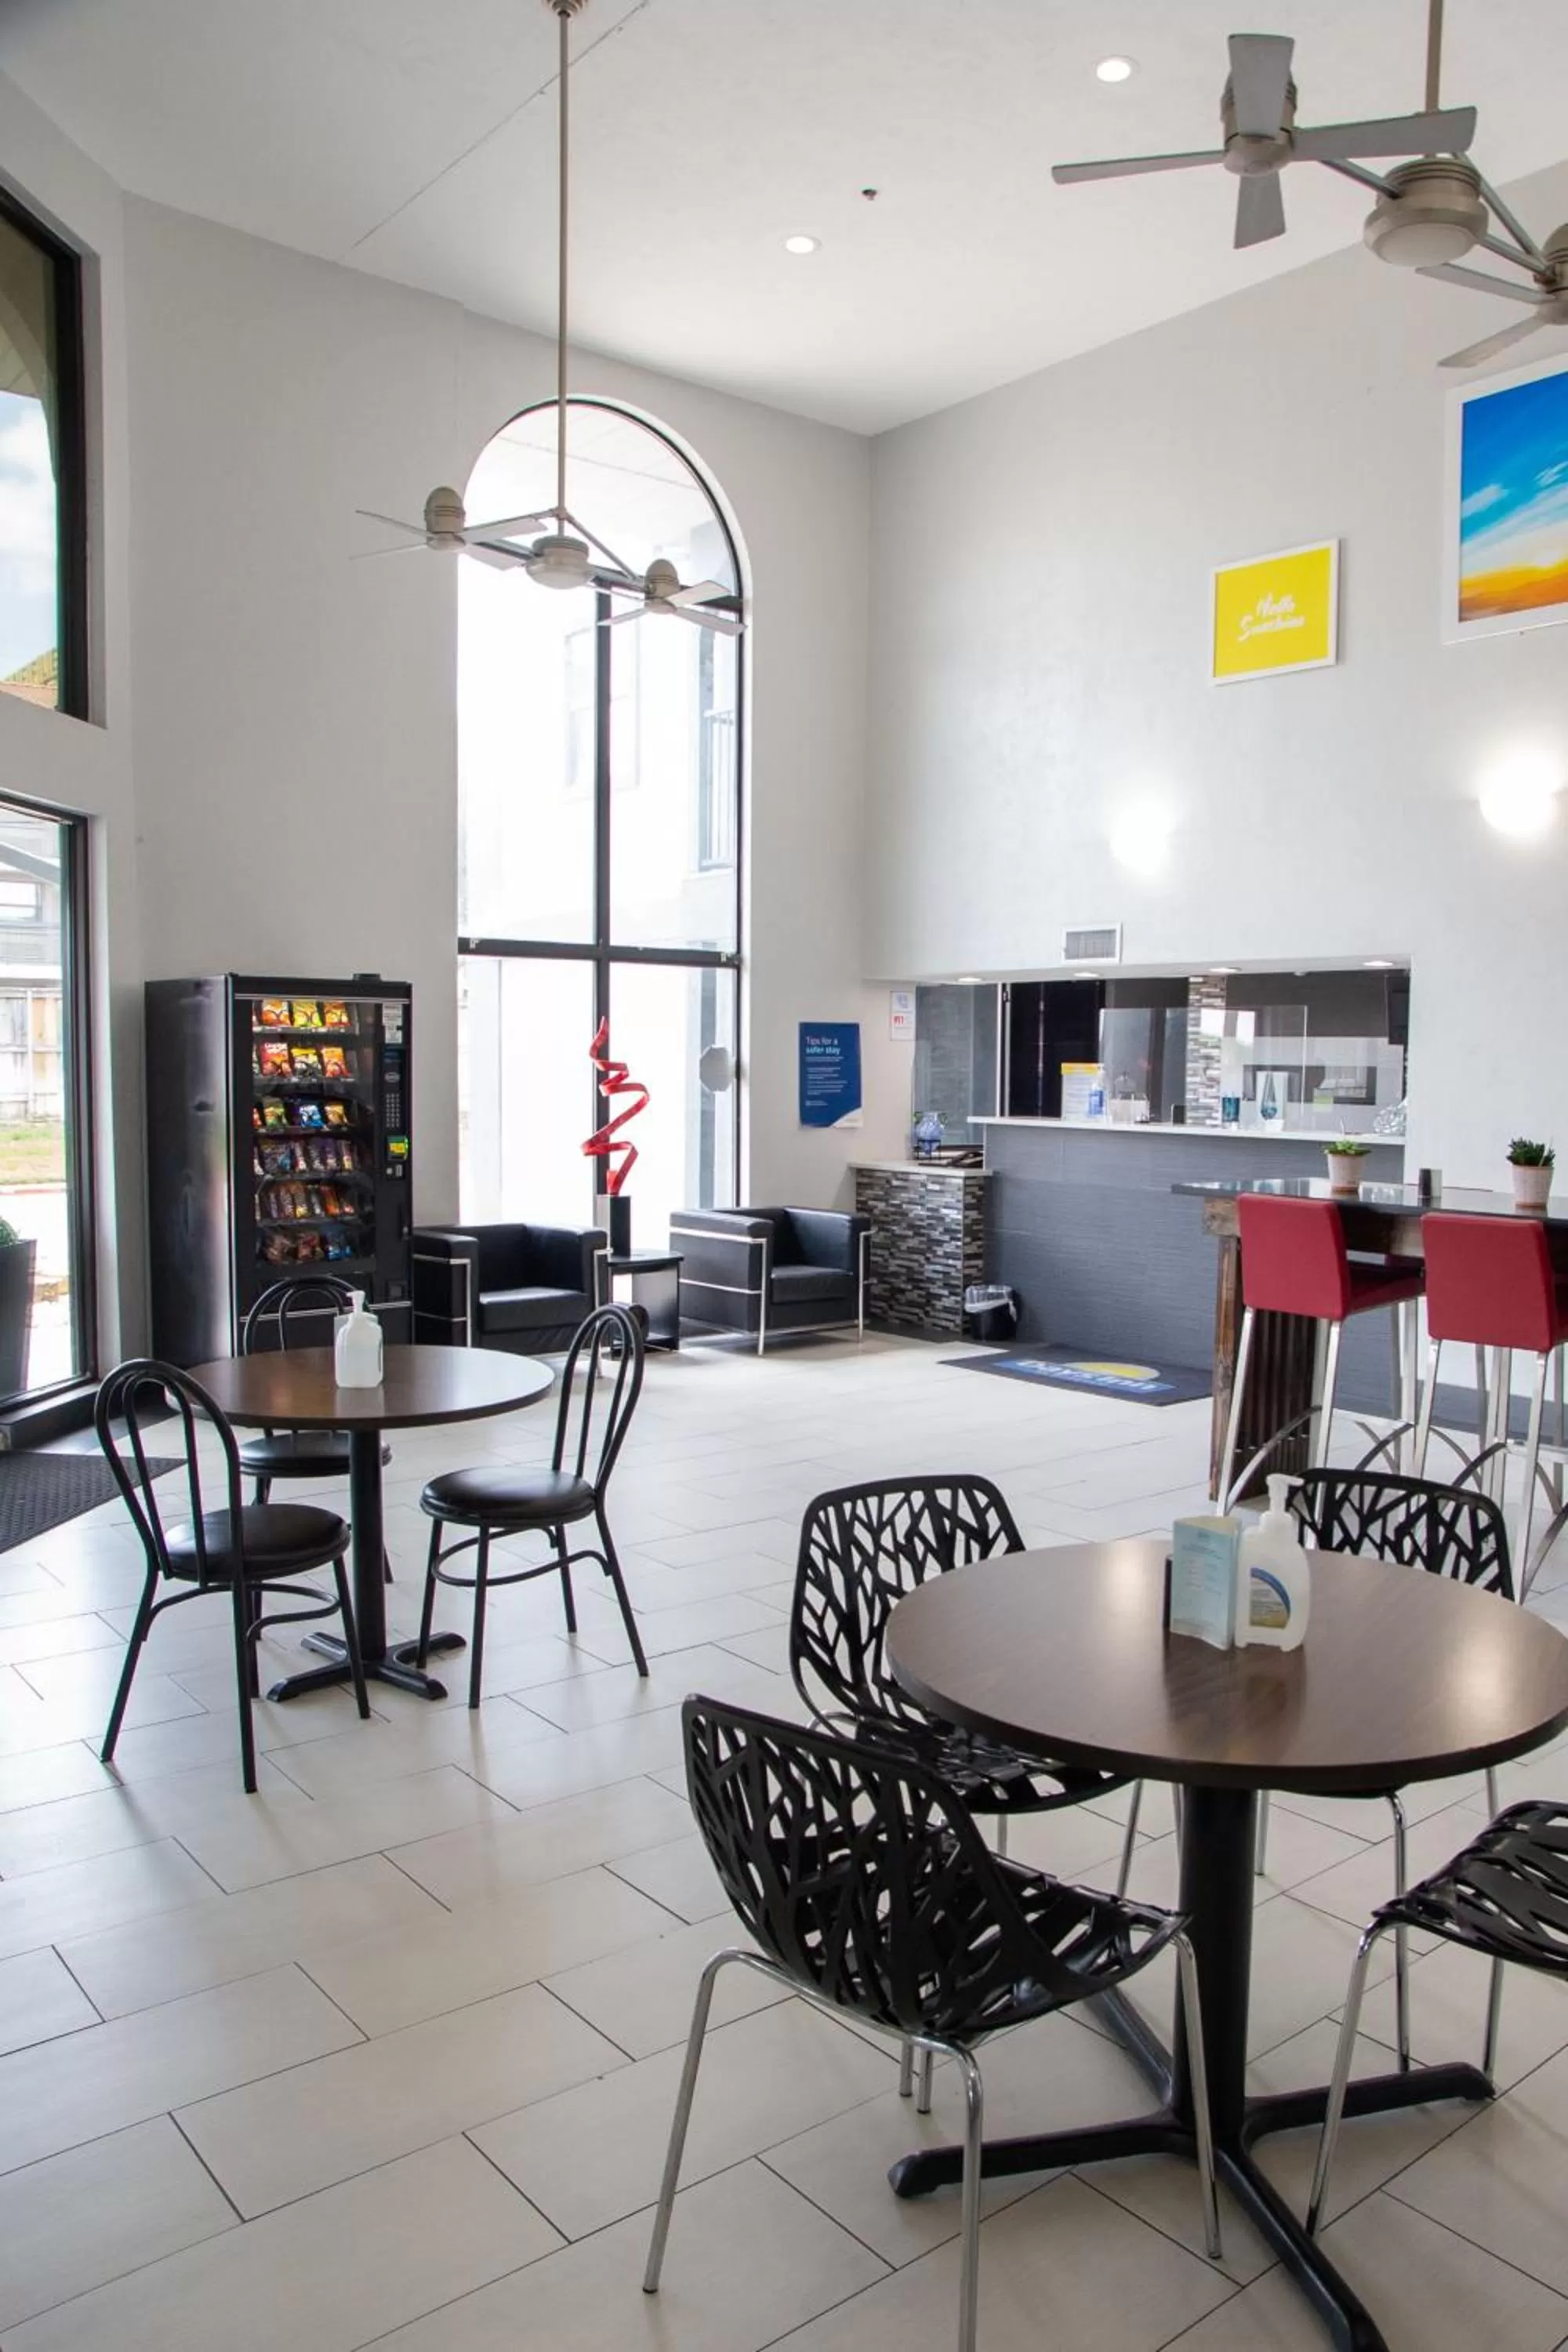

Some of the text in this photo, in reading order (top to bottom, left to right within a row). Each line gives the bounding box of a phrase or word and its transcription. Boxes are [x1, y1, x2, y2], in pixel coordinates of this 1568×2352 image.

[806, 1036, 820, 1046] Tips
[822, 1036, 832, 1045] for
[806, 1046, 841, 1055] safer stay
